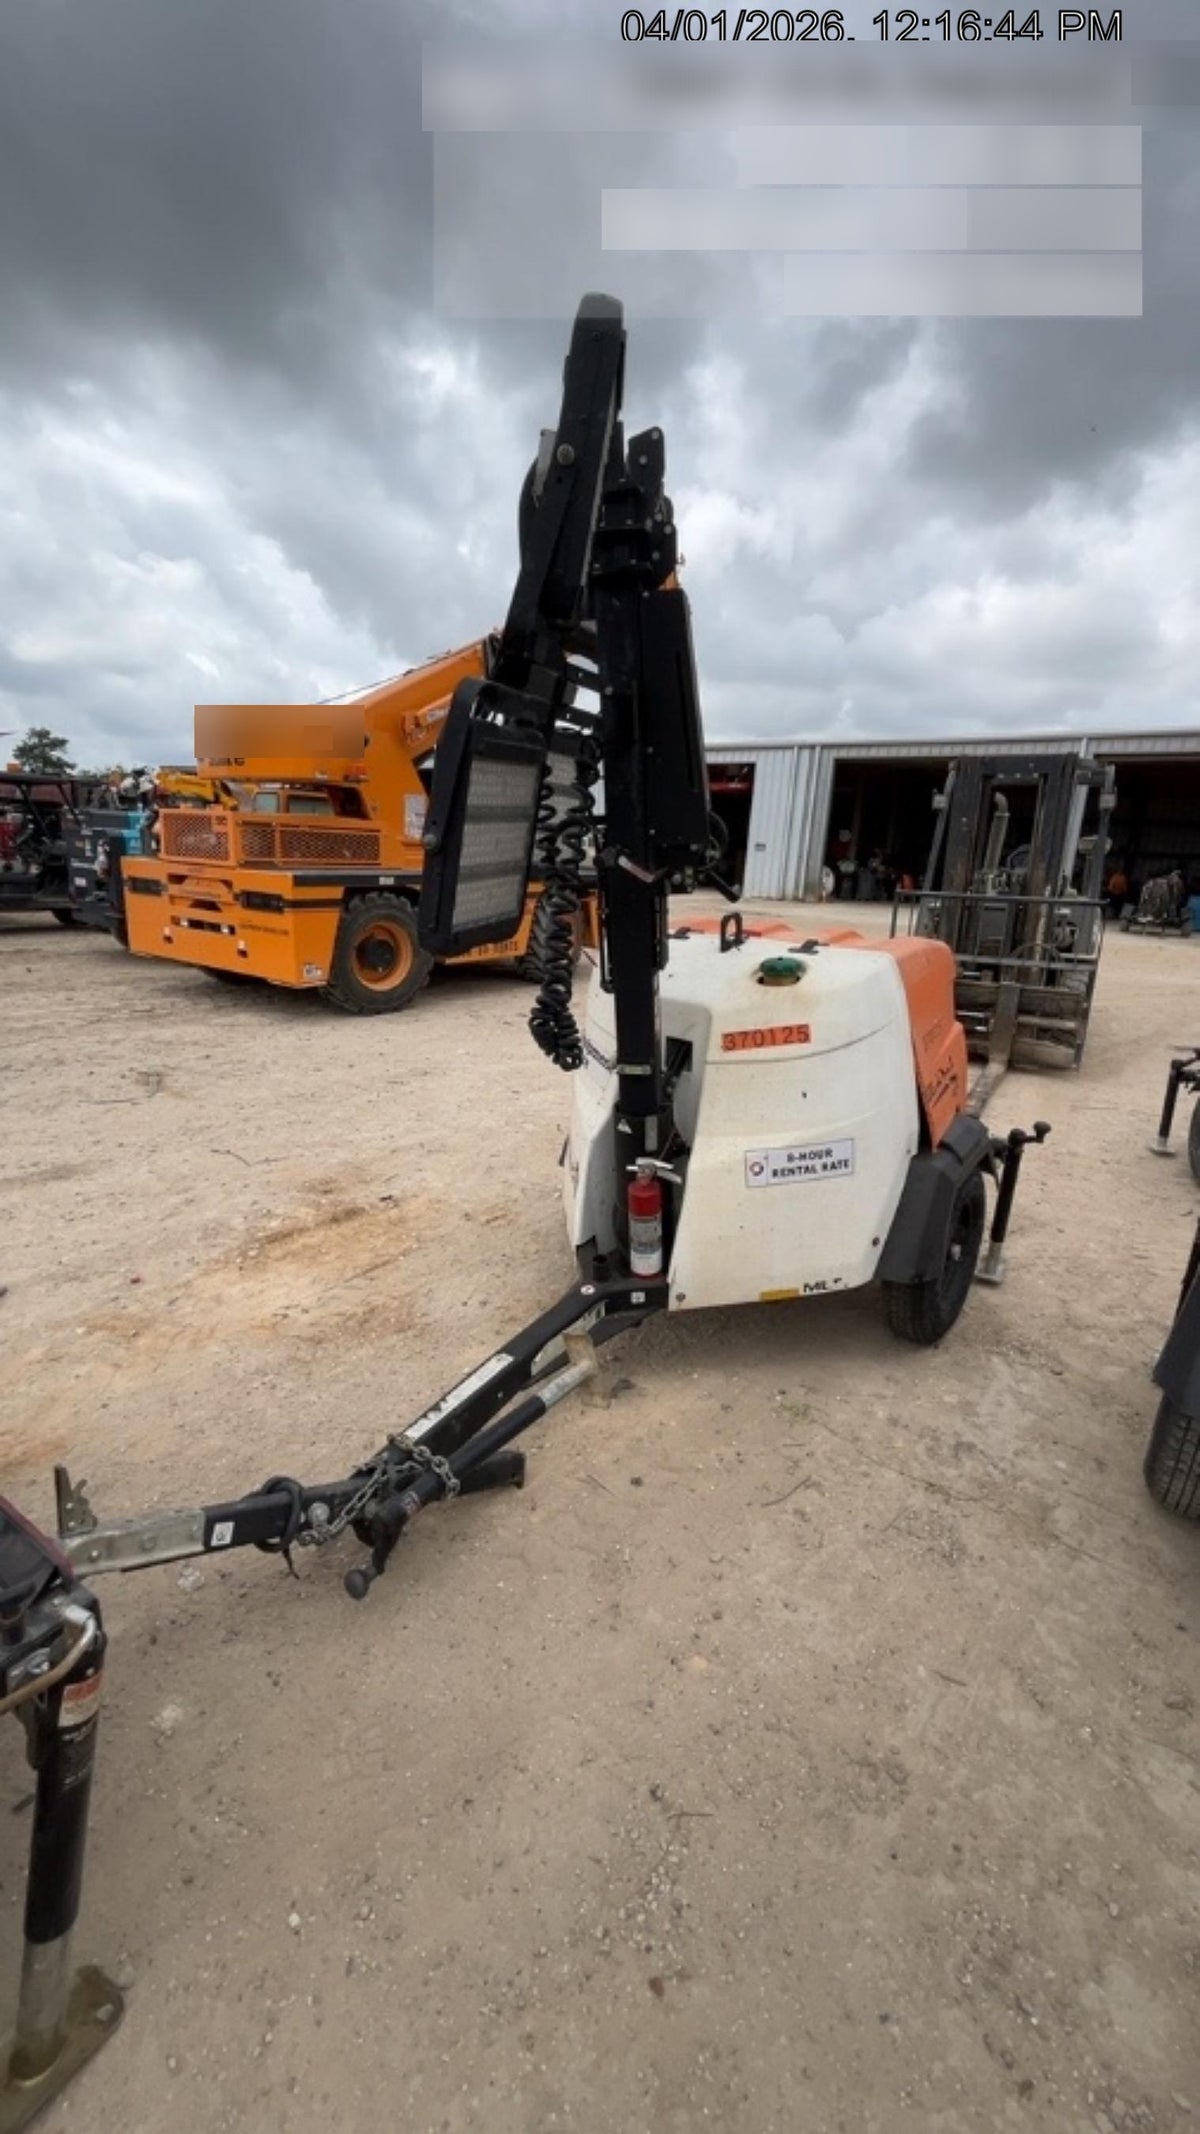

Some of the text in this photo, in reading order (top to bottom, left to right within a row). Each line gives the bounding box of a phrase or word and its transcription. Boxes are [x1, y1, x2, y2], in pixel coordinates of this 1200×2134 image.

[722, 1024, 809, 1051] 370125
[772, 1158, 850, 1178] RENTAL RATE
